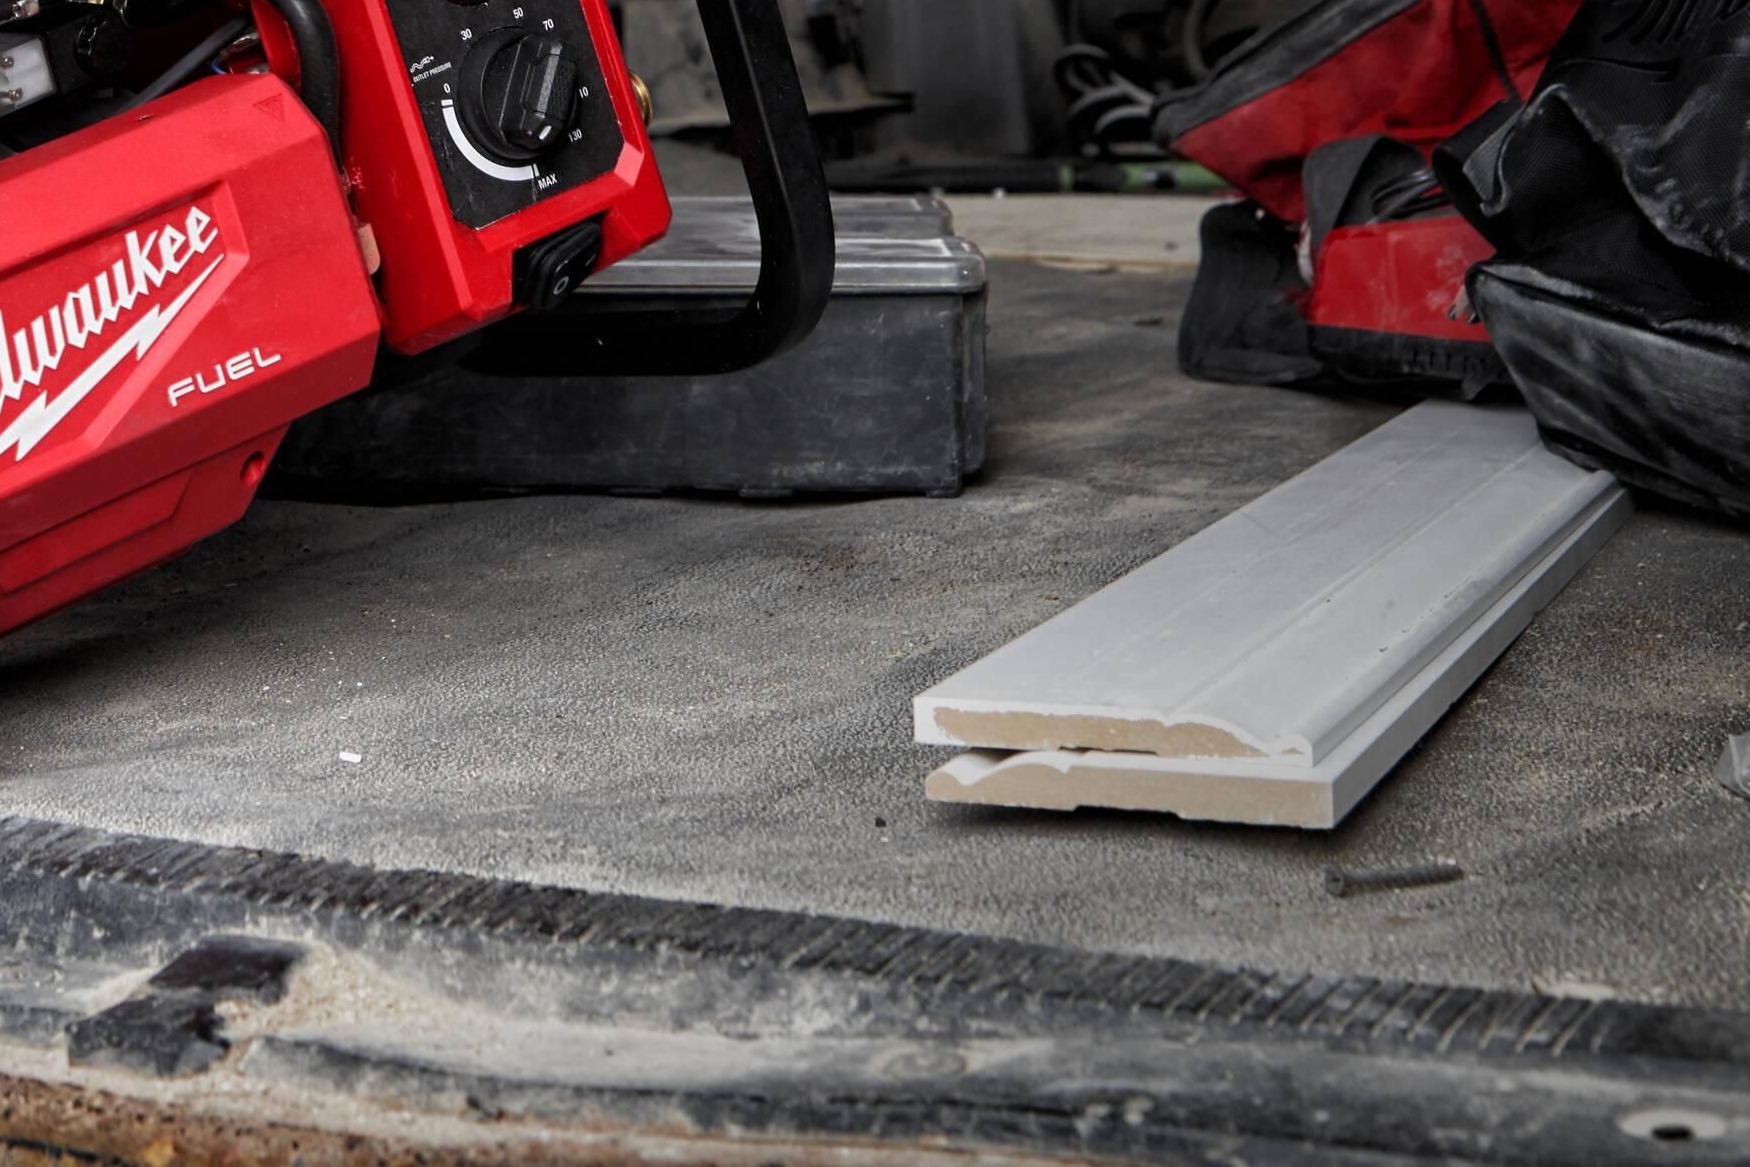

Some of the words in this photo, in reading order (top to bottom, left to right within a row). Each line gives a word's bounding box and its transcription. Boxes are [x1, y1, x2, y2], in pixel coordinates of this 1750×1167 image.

[512, 6, 524, 19] 50
[542, 18, 554, 31] 70
[460, 28, 472, 41] 30
[443, 83, 451, 94] 0
[578, 86, 589, 99] 10
[568, 129, 583, 143] 130
[538, 173, 558, 190] MAX
[167, 347, 282, 408] FUEL
